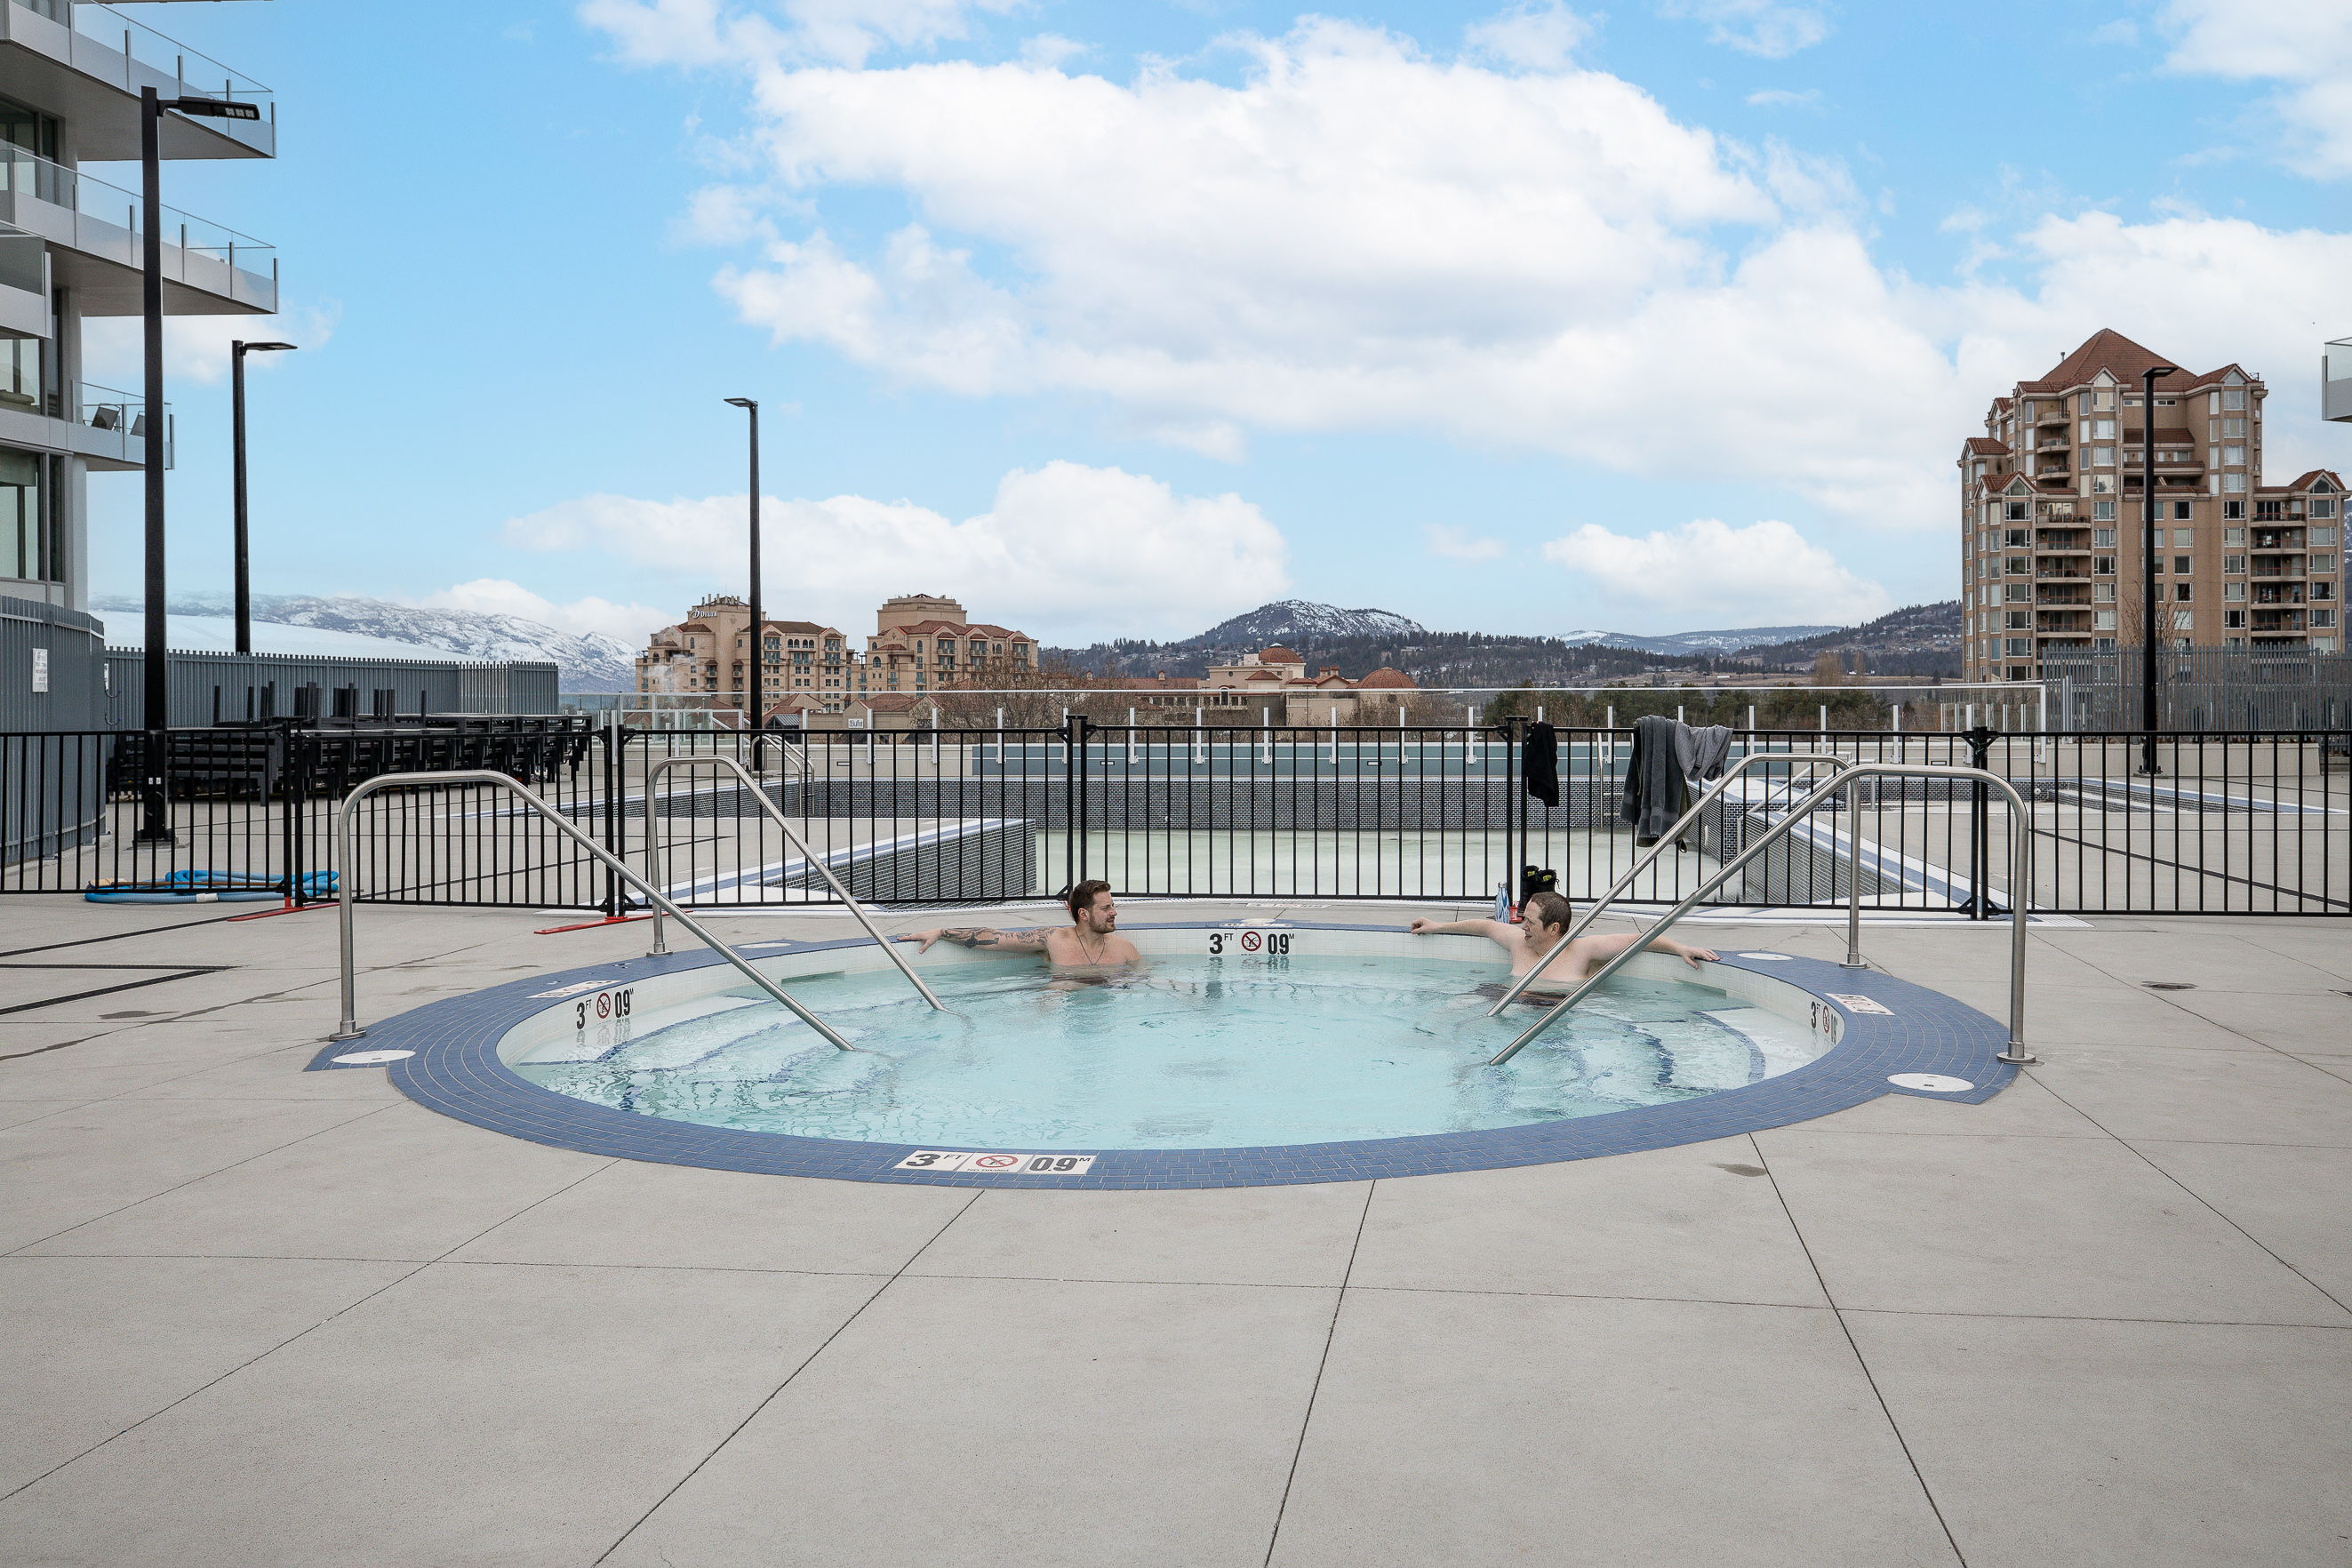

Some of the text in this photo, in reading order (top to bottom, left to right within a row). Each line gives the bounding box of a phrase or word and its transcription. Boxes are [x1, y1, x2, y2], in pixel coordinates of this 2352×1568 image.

[1210, 933, 1223, 955] 3
[1268, 933, 1289, 955] 0.9
[577, 1003, 585, 1029] 3
[586, 999, 592, 1010] FT
[615, 989, 630, 1018] 0.9
[1812, 1001, 1816, 1028] 3
[906, 1153, 940, 1167] 3
[1028, 1156, 1078, 1172] 0.9
